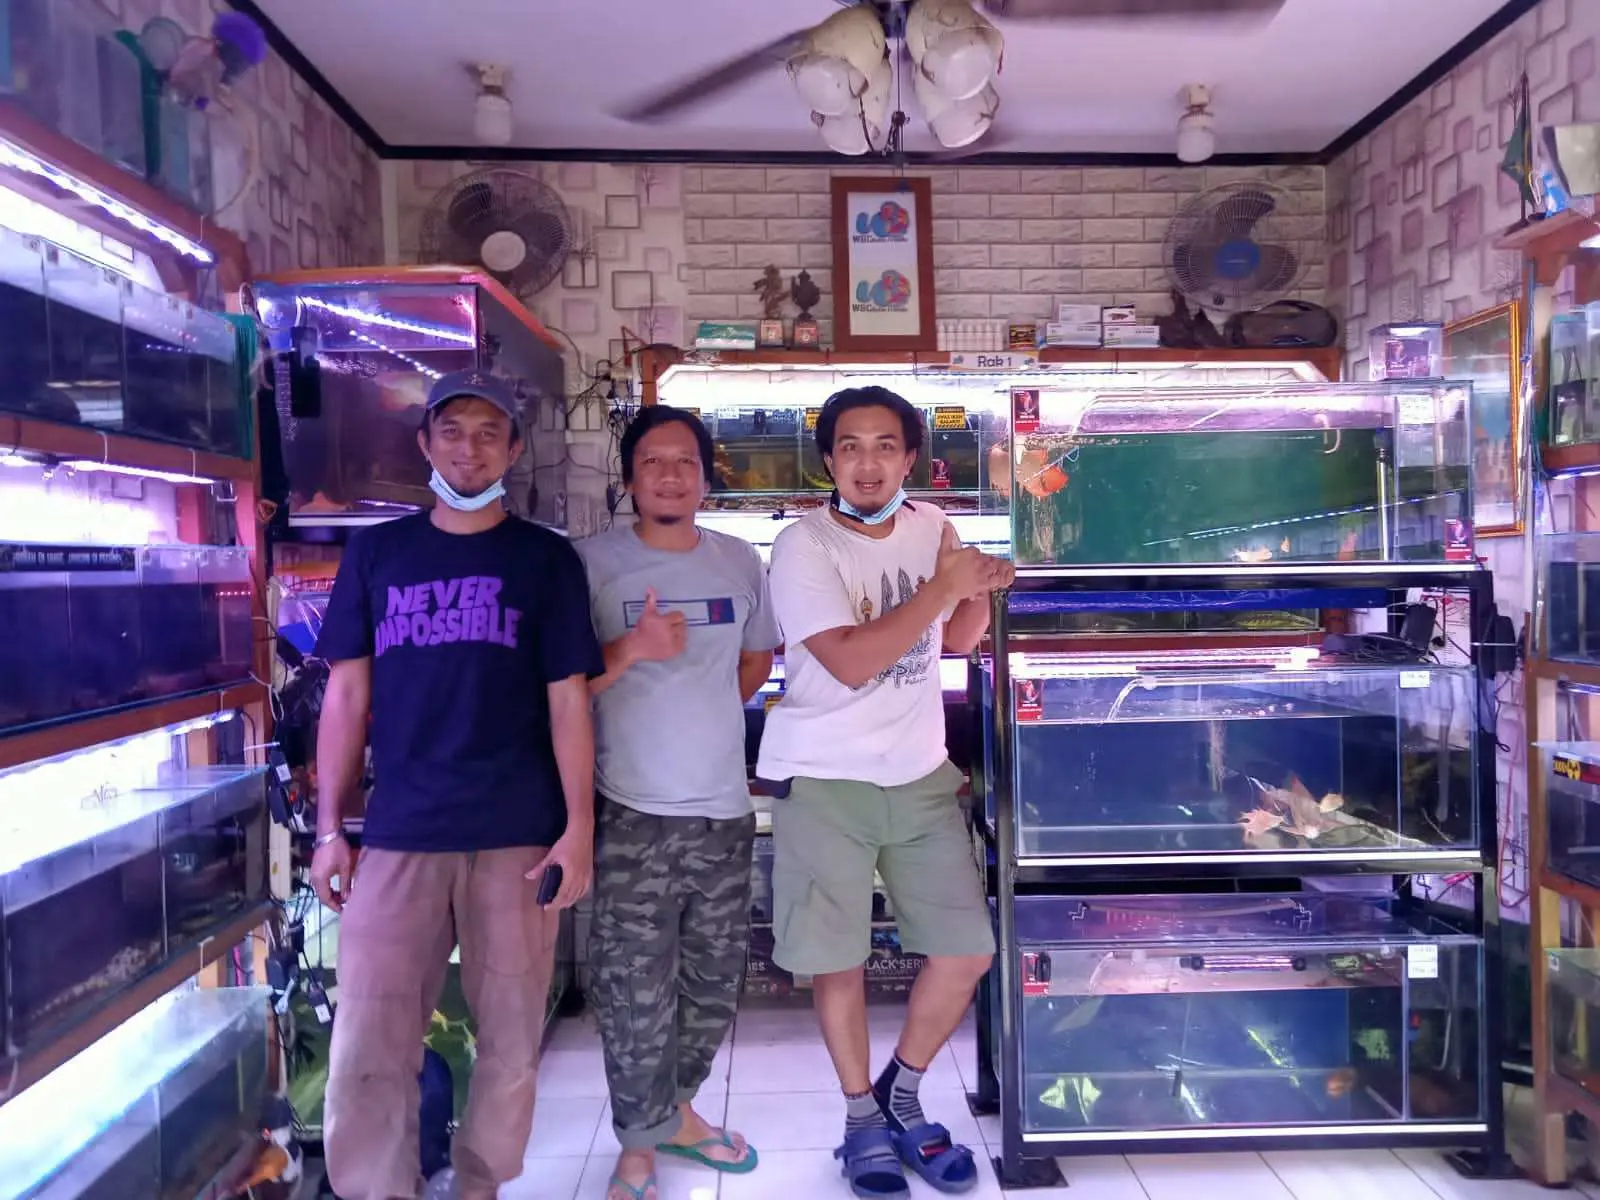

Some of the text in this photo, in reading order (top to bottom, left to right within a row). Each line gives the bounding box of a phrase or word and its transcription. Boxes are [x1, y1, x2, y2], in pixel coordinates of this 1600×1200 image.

[977, 355, 1012, 367] Rak 1
[386, 575, 503, 617] NEVER
[375, 605, 523, 657] IMPOSSIBLE
[864, 959, 897, 970] LACK
